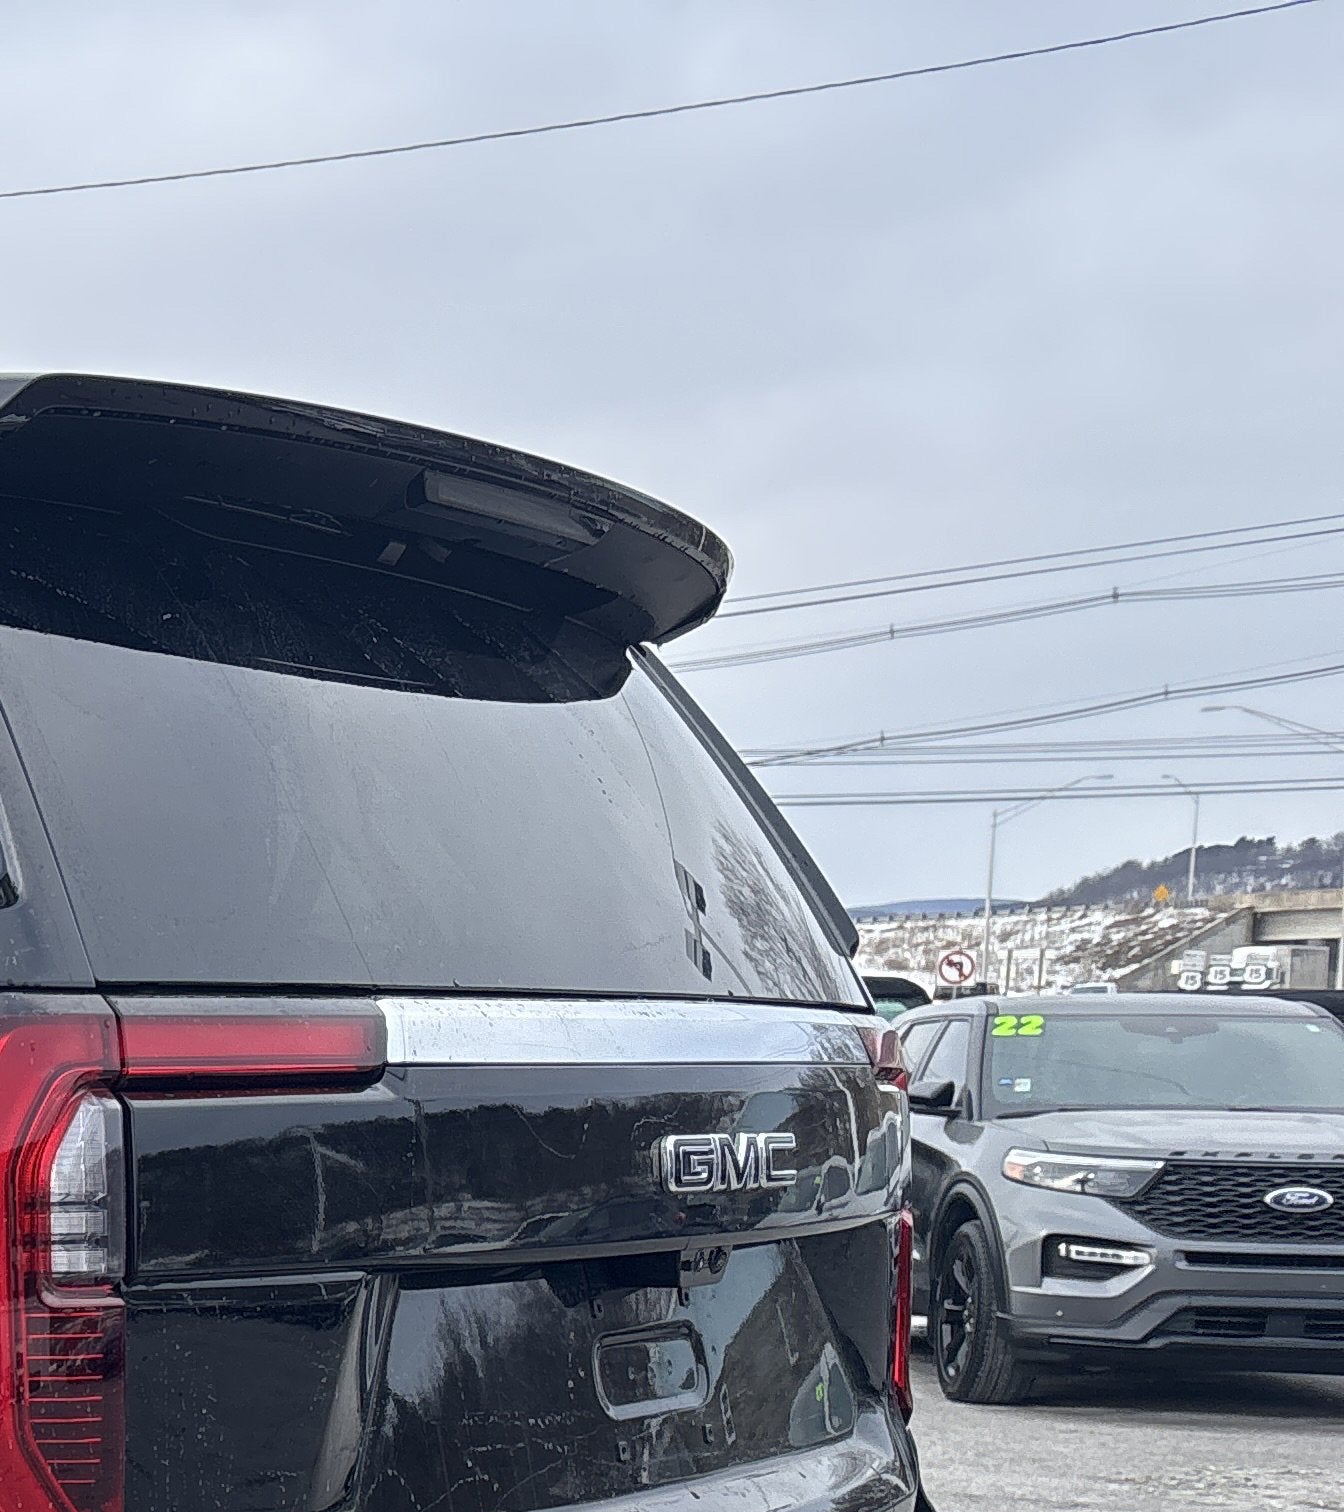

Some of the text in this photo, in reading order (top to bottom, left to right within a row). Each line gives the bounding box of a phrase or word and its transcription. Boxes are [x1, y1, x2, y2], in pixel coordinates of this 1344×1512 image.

[1214, 969, 1226, 980] 15
[992, 1015, 1045, 1036] 22
[663, 1131, 799, 1193] GMC
